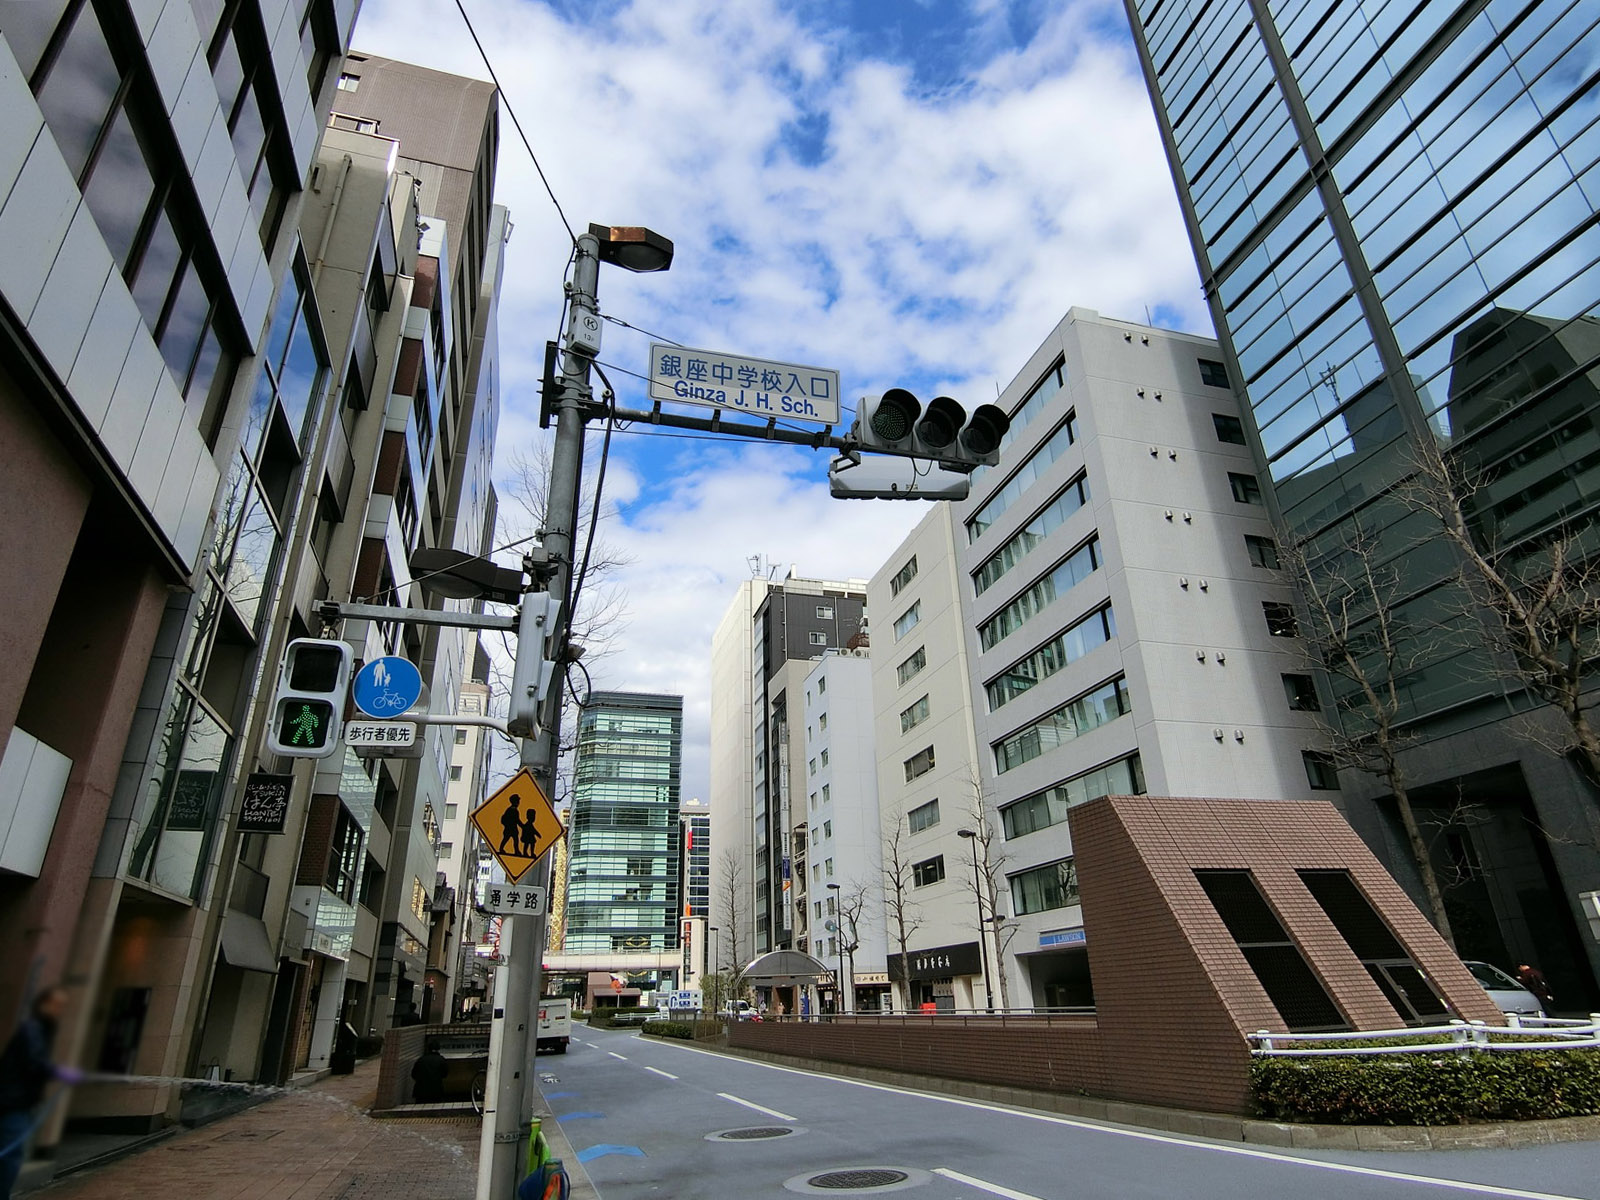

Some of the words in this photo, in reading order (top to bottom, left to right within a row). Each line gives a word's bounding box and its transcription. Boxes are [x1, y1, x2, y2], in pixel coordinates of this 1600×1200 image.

[659, 354, 830, 398] 銀座中学校入口
[674, 380, 726, 403] Ginza
[735, 390, 749, 407] J.
[756, 392, 774, 411] H.
[781, 396, 818, 417] Sch.
[349, 727, 410, 741] 歩行者優先
[244, 795, 286, 811] はん亭
[244, 809, 283, 817] HANTEI
[490, 889, 538, 910] 通学路
